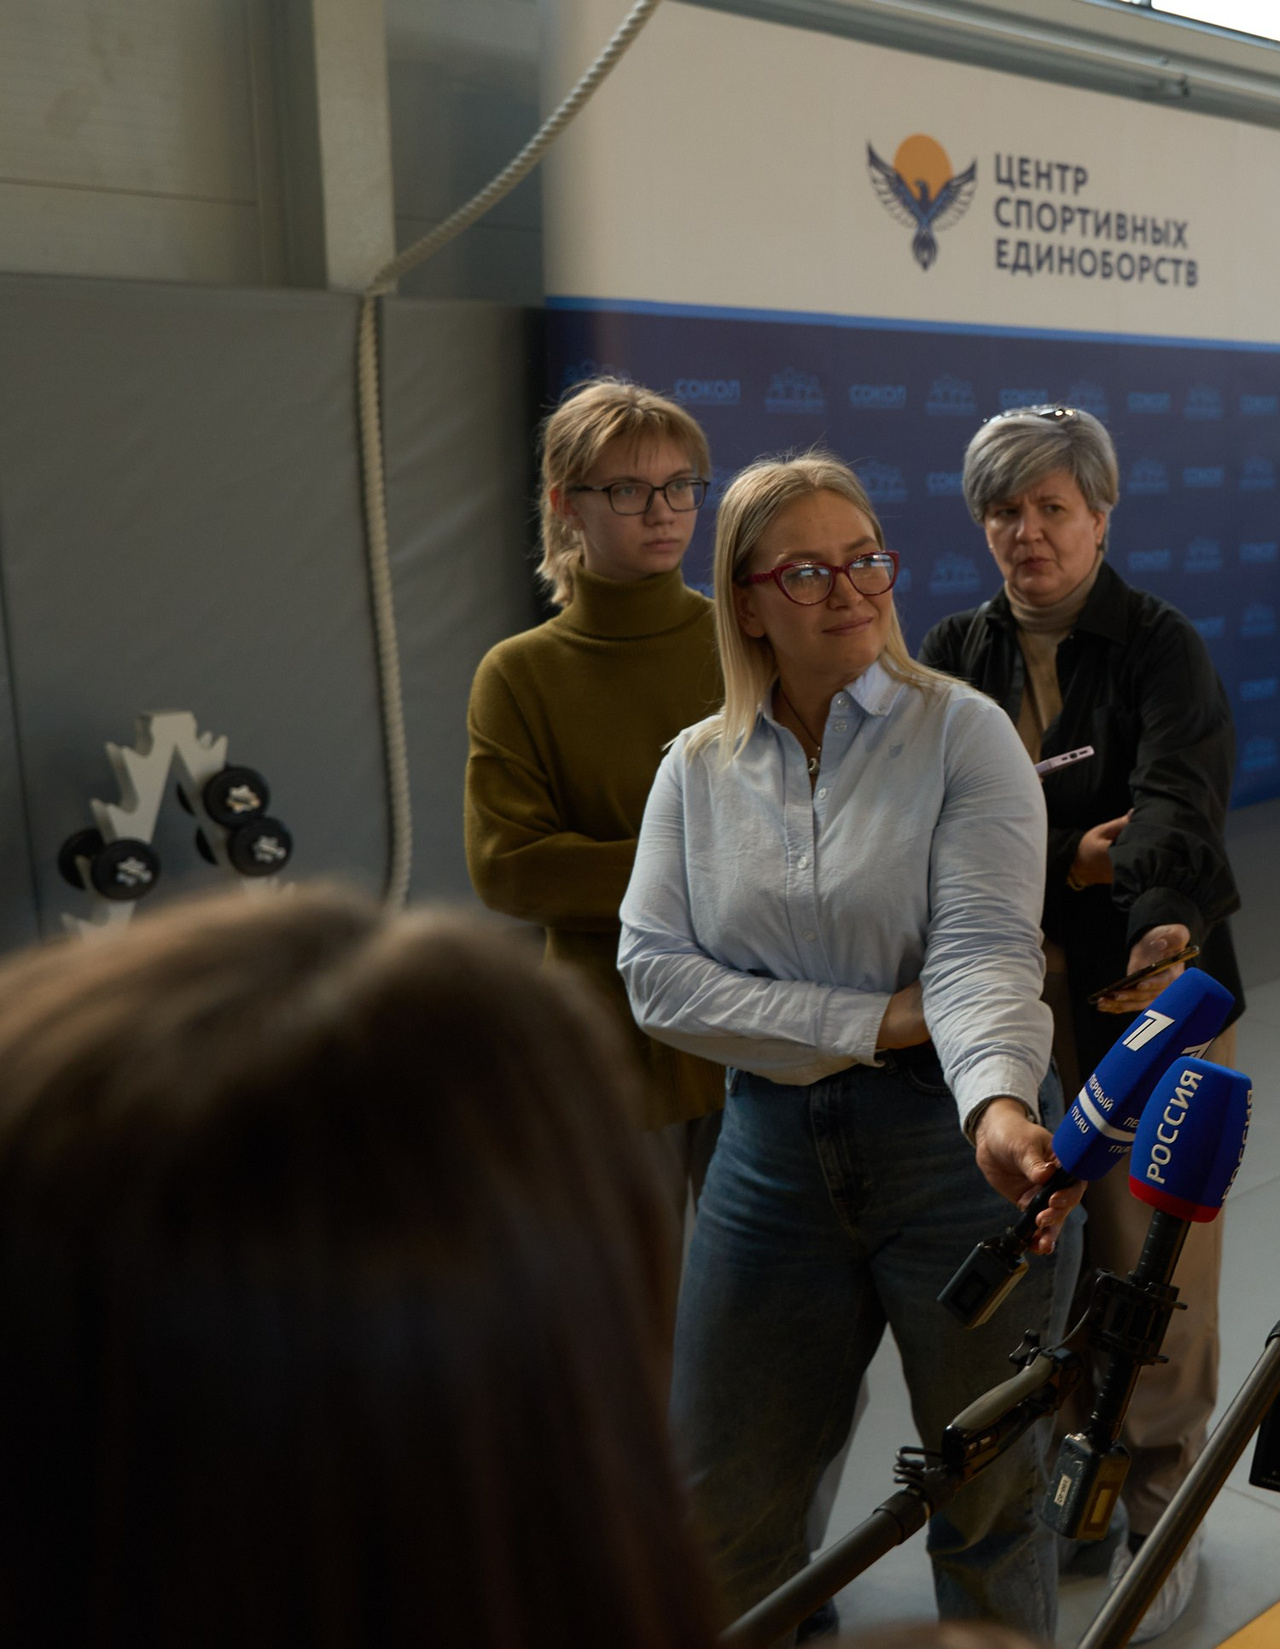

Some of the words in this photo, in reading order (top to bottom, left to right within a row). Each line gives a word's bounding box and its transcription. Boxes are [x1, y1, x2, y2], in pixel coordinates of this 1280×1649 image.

[995, 154, 1089, 195] ЦЕНТР
[994, 197, 1189, 249] СПОРТИВНЫХ
[995, 239, 1198, 288] ЕДИНОБОРСТВ
[1088, 1073, 1114, 1112] ПЕРВЫЙ
[1070, 1105, 1090, 1134] 1TV.RU
[1146, 1069, 1204, 1184] РОССИЯ
